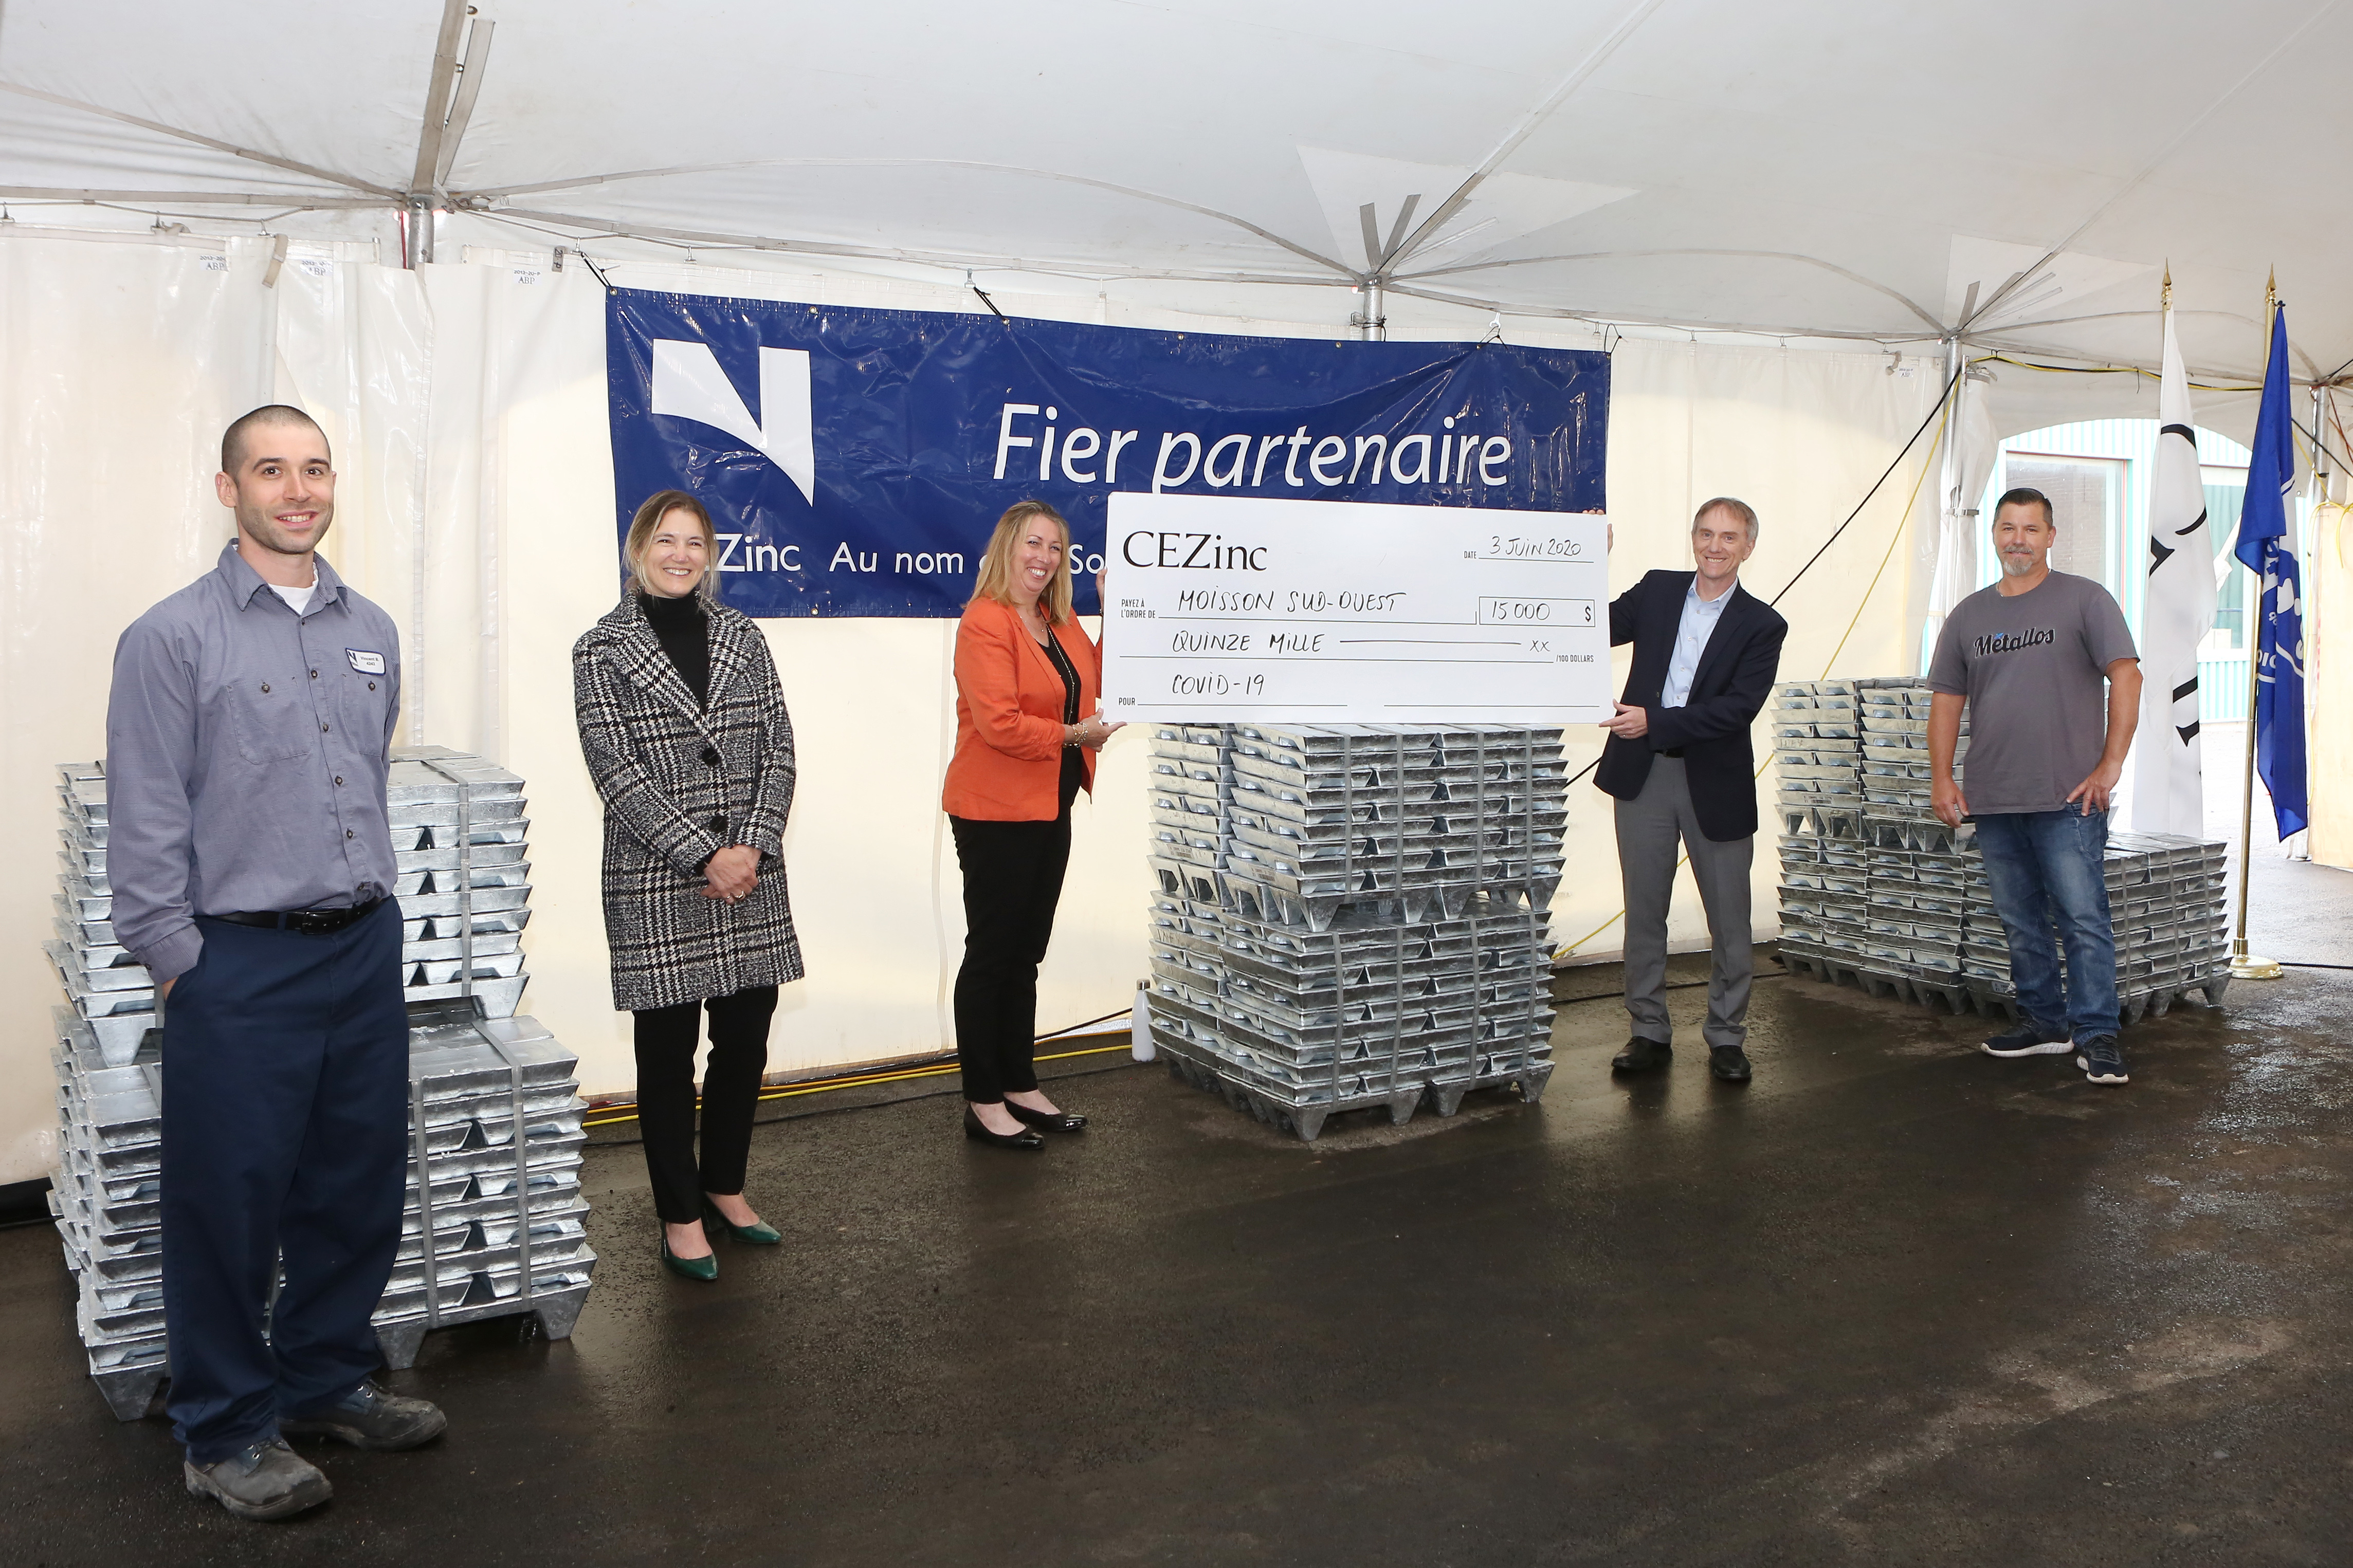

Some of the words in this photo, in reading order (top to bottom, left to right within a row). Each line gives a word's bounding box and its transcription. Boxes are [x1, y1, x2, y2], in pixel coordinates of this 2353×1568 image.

[993, 402, 1138, 483] Fier
[1152, 416, 1511, 493] partenaire
[705, 533, 801, 572] Zinc
[829, 542, 878, 573] Au
[895, 553, 963, 574] nom
[1123, 531, 1267, 571] CEZinc
[1464, 550, 1476, 559] DATE
[1490, 536, 1501, 555] 3
[1547, 538, 1581, 557] 2020
[1121, 610, 1146, 618] L'ORDRE
[1148, 610, 1156, 619] DE
[1178, 585, 1274, 612] MOISSON
[1287, 591, 1407, 613] SUD-OUEST
[1121, 599, 1139, 607] PAYEZ
[1141, 598, 1145, 607] À
[1492, 601, 1507, 620] 15
[1513, 603, 1551, 621] 000
[1585, 605, 1591, 622] $
[1172, 630, 1251, 653] QUINZE
[1269, 633, 1325, 654] MILLE
[1570, 654, 1594, 662] DOLLARS
[1172, 672, 1264, 696] COVID-19
[1119, 697, 1136, 706] POUR
